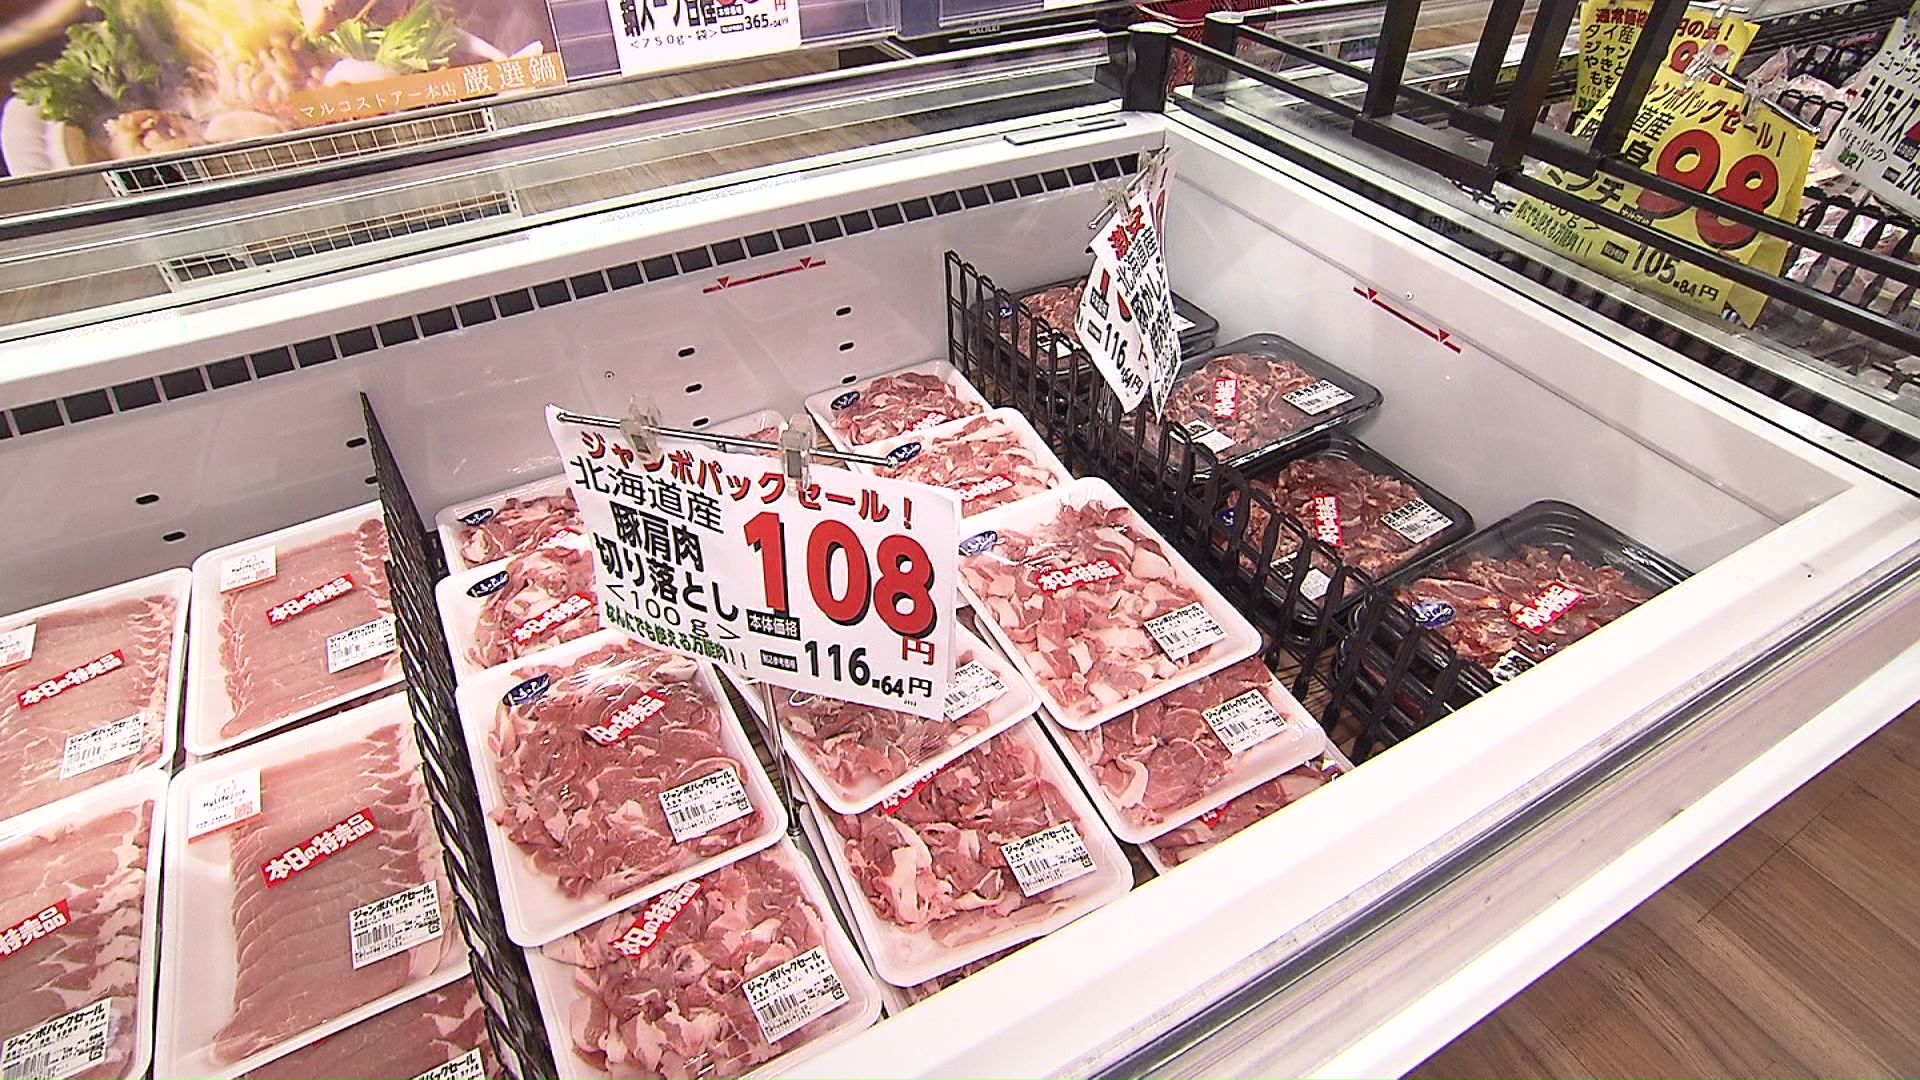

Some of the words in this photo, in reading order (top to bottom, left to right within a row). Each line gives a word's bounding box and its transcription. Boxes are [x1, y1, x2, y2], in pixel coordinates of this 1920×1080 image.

[1585, 24, 1635, 45] タイ産
[463, 55, 557, 95] 厳選鍋
[300, 83, 457, 118] マルコストアー本店
[1631, 241, 1720, 301] 105.84円
[570, 455, 725, 535] 北海道産
[580, 430, 914, 530] ジャンボパックセール！
[608, 500, 705, 573] 豚肩肉
[592, 531, 740, 622] 切り落とし
[742, 510, 937, 639] 108
[1037, 560, 1120, 592] 本日の特売品
[268, 577, 353, 622] 本日の特売品
[511, 594, 593, 642] 本日の特売品
[605, 583, 741, 640] ＜100g＞
[1147, 605, 1200, 629] ジャンボパックセール
[748, 612, 799, 639] 本体価格
[803, 639, 933, 698] 116.64円
[902, 636, 936, 666] 円
[20, 652, 123, 706] 本日の特売品
[583, 694, 666, 743] 日の特売品
[1205, 692, 1259, 720] ジャンボパックセール
[663, 770, 733, 802] ジャンボパックセール
[264, 813, 375, 882] 本日の特売品
[1005, 825, 1071, 855] ジャンボパックセール
[352, 884, 433, 921] ジャンボパックセール
[612, 880, 701, 956] 本日の特売品
[747, 950, 822, 994] ジャンボパックセール
[7, 1002, 105, 1052] ジャンボパックセール
